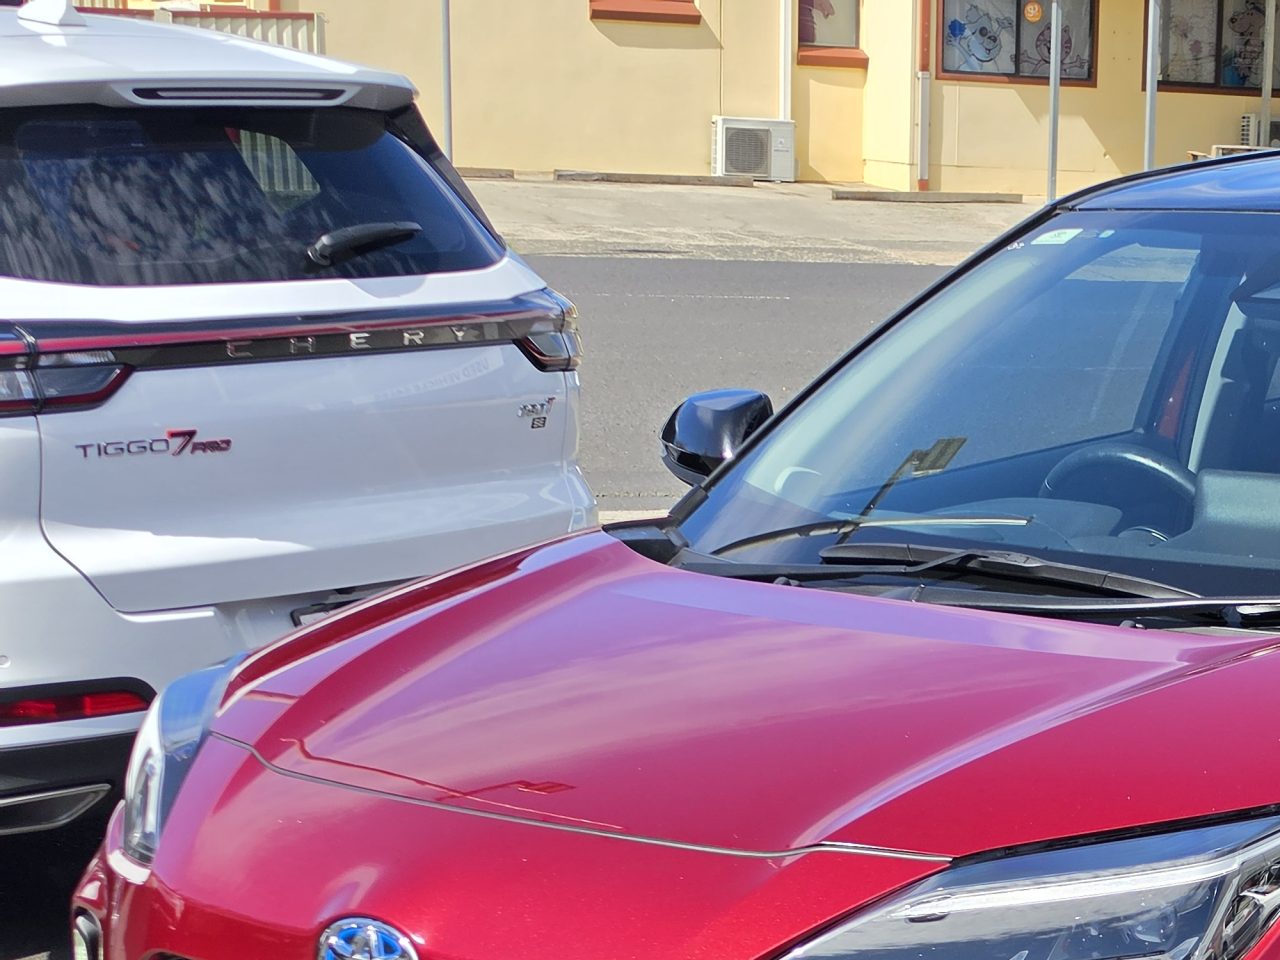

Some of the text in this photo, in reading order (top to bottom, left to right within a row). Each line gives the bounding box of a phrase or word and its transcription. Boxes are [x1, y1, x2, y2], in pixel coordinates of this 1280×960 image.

[226, 325, 467, 358] CHERY
[75, 439, 169, 458] TIGGO
[167, 429, 197, 456] 7
